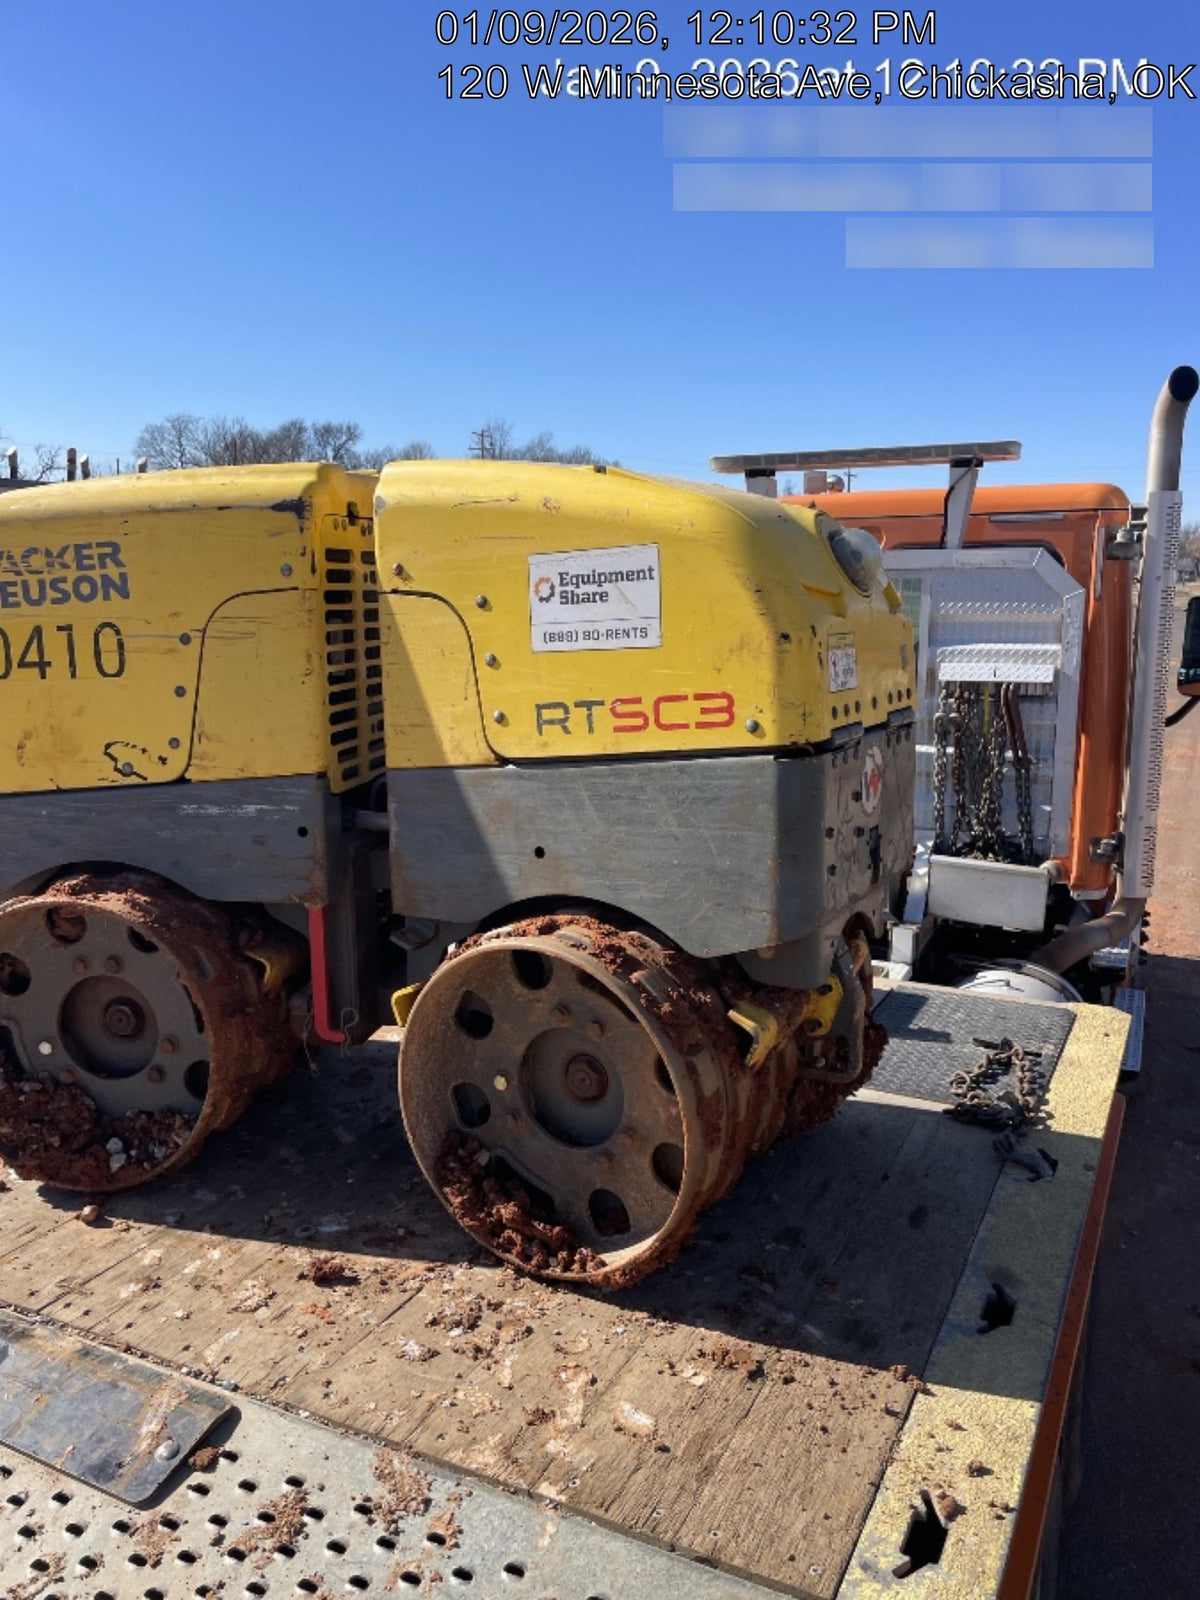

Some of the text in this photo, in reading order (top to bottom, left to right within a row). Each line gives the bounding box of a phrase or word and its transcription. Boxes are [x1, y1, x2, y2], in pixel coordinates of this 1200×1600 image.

[0, 541, 126, 576] ACKER
[0, 572, 130, 608] EUSON
[558, 565, 655, 589] Equipment
[559, 589, 609, 605] Share
